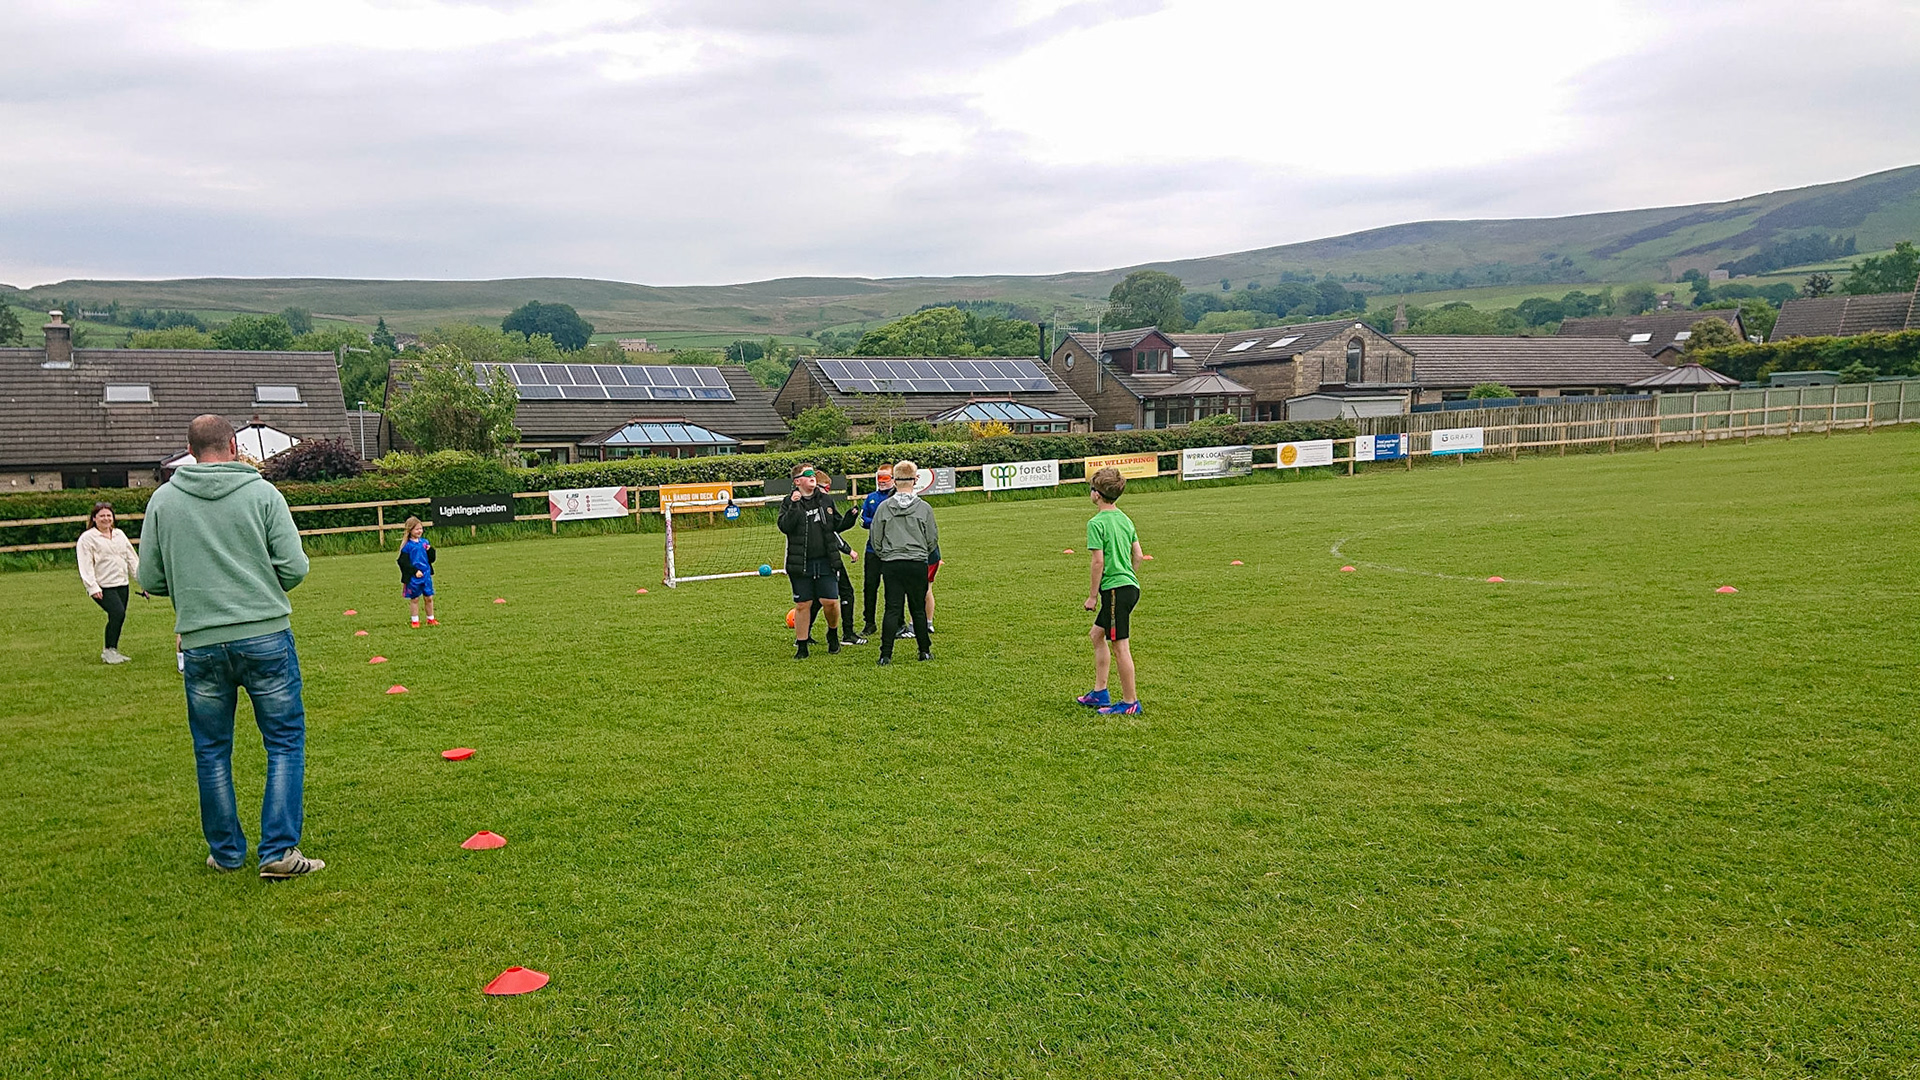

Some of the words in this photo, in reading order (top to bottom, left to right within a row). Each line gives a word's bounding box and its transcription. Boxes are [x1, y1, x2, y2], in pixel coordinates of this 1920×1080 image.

[1105, 456, 1155, 466] WELLSPRINGS
[1020, 464, 1052, 474] forest
[440, 503, 507, 517] Lightingspiration
